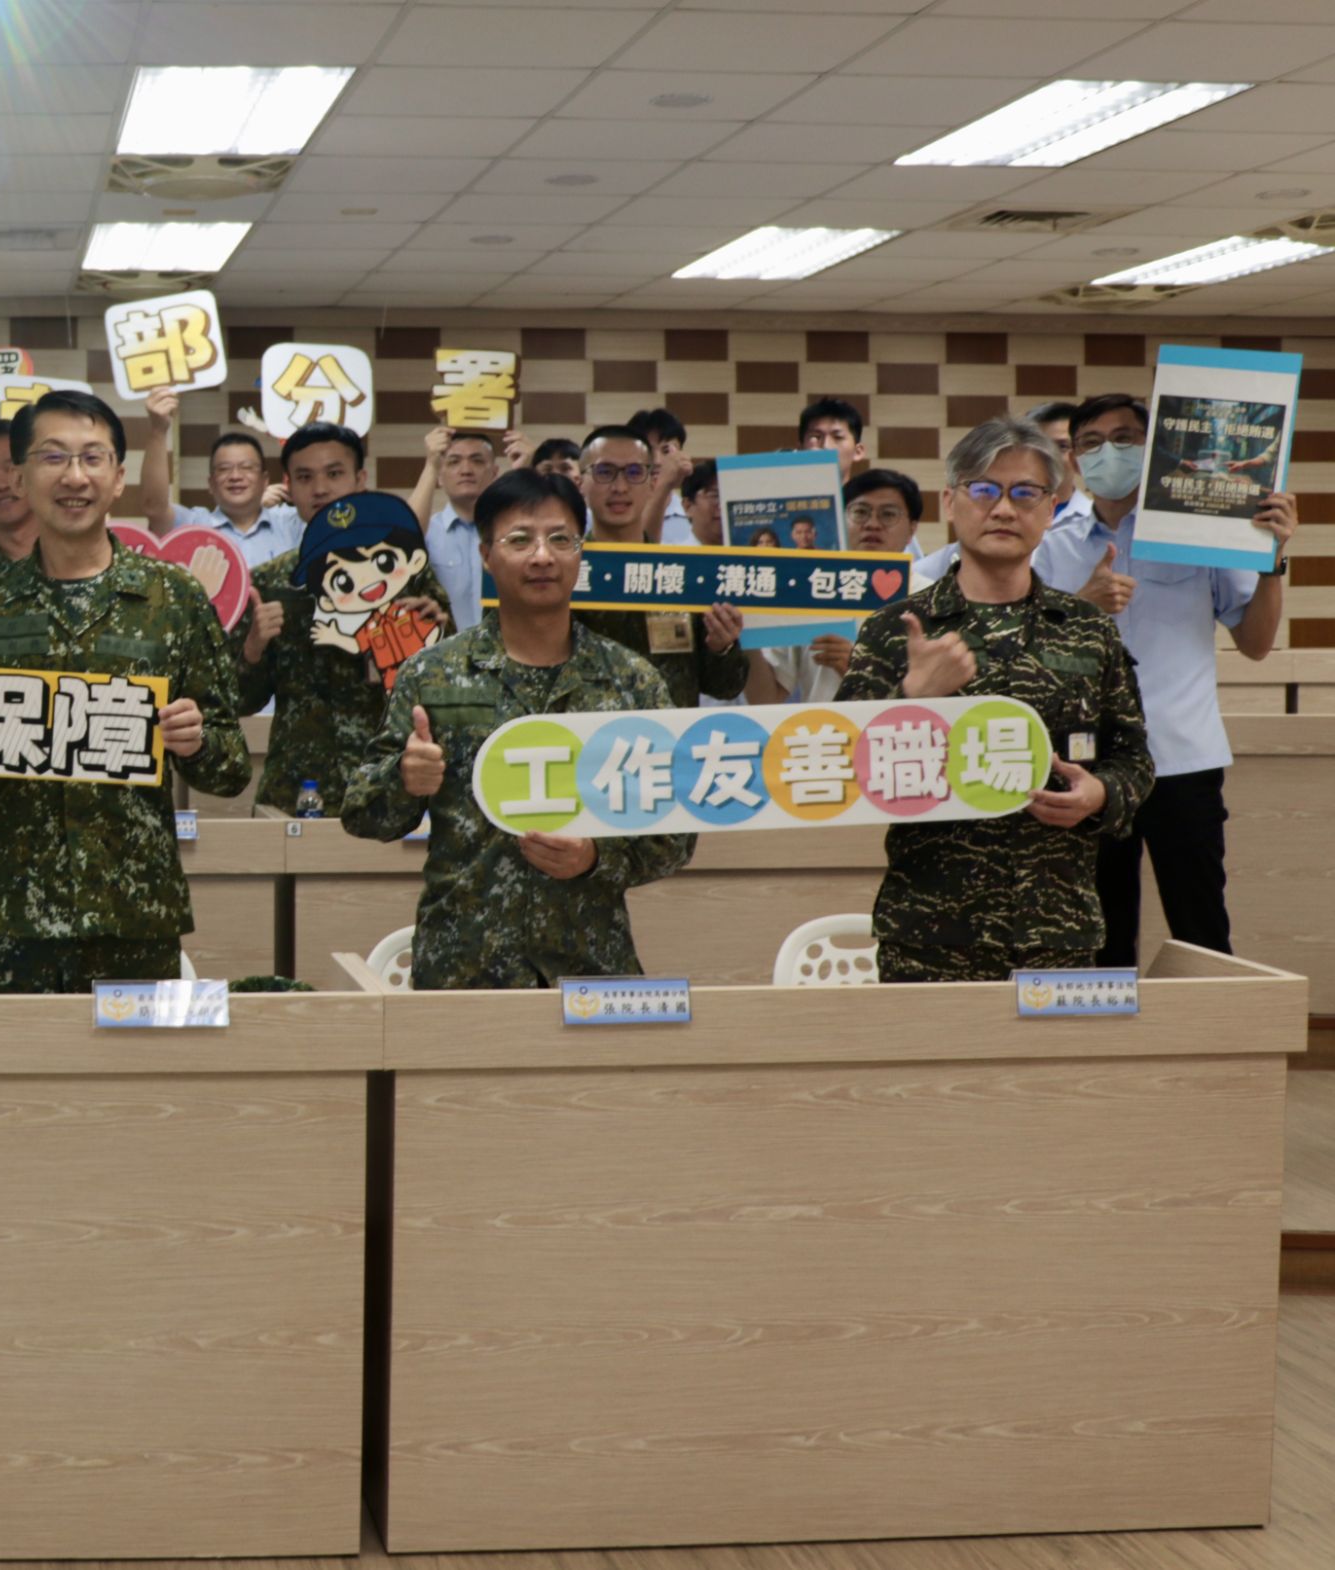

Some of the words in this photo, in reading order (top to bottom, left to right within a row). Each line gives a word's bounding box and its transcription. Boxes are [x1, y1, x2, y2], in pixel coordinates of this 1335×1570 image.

[116, 304, 217, 391] 部
[431, 348, 519, 430] 署
[273, 352, 366, 435] 分
[498, 716, 1032, 816] 工作友善職場
